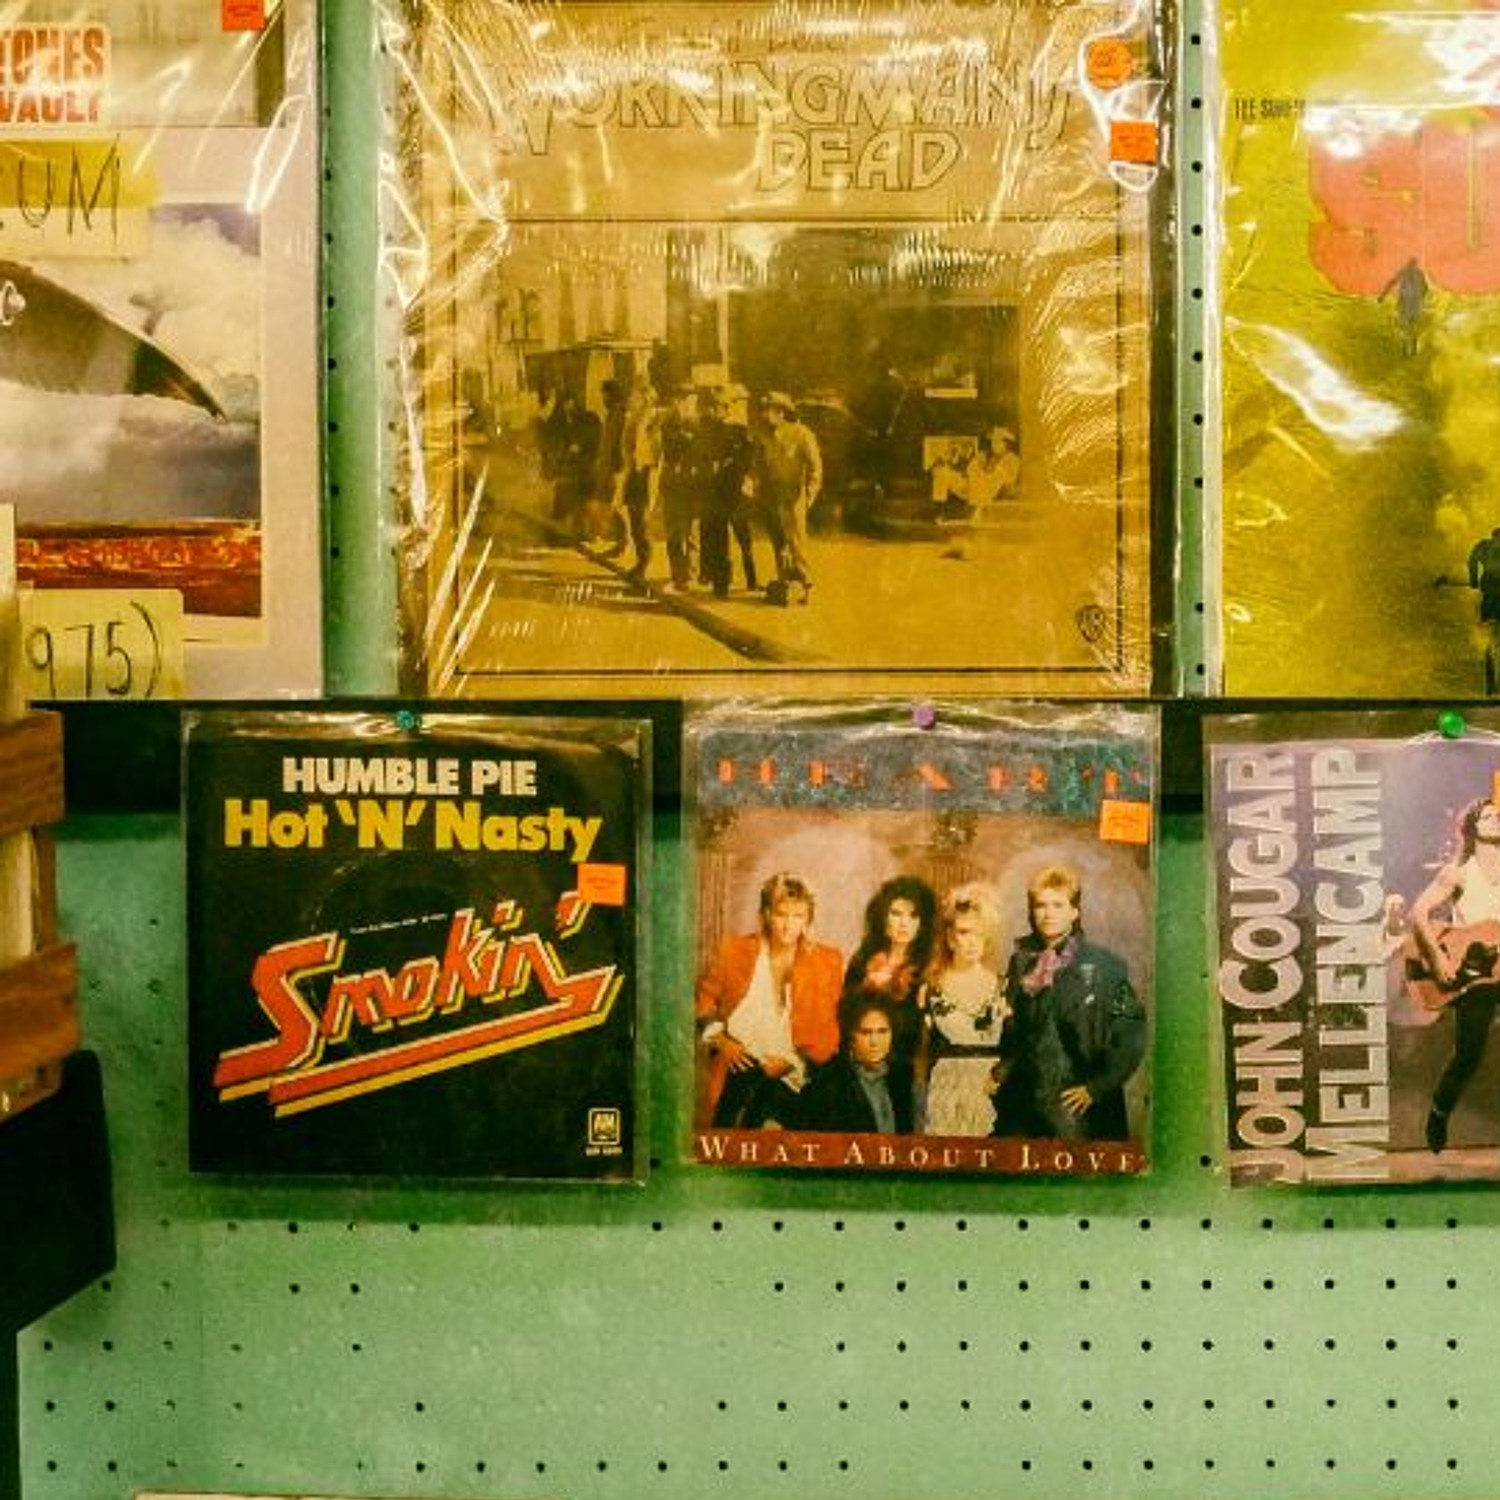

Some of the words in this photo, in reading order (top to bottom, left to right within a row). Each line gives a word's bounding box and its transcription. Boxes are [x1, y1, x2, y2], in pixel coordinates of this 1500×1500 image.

[224, 798, 328, 848] Hot
[435, 801, 603, 862] Nasty
[282, 757, 459, 795] HUMBLE
[471, 760, 538, 796] PIE
[1219, 750, 1303, 1010] COUGAR
[1305, 747, 1390, 1182] MELLENCAMP
[699, 1134, 820, 1164] WHAT
[844, 1139, 995, 1169] ABOUT
[1021, 1144, 1140, 1172] LOVE
[1230, 1020, 1307, 1185] JOHN
